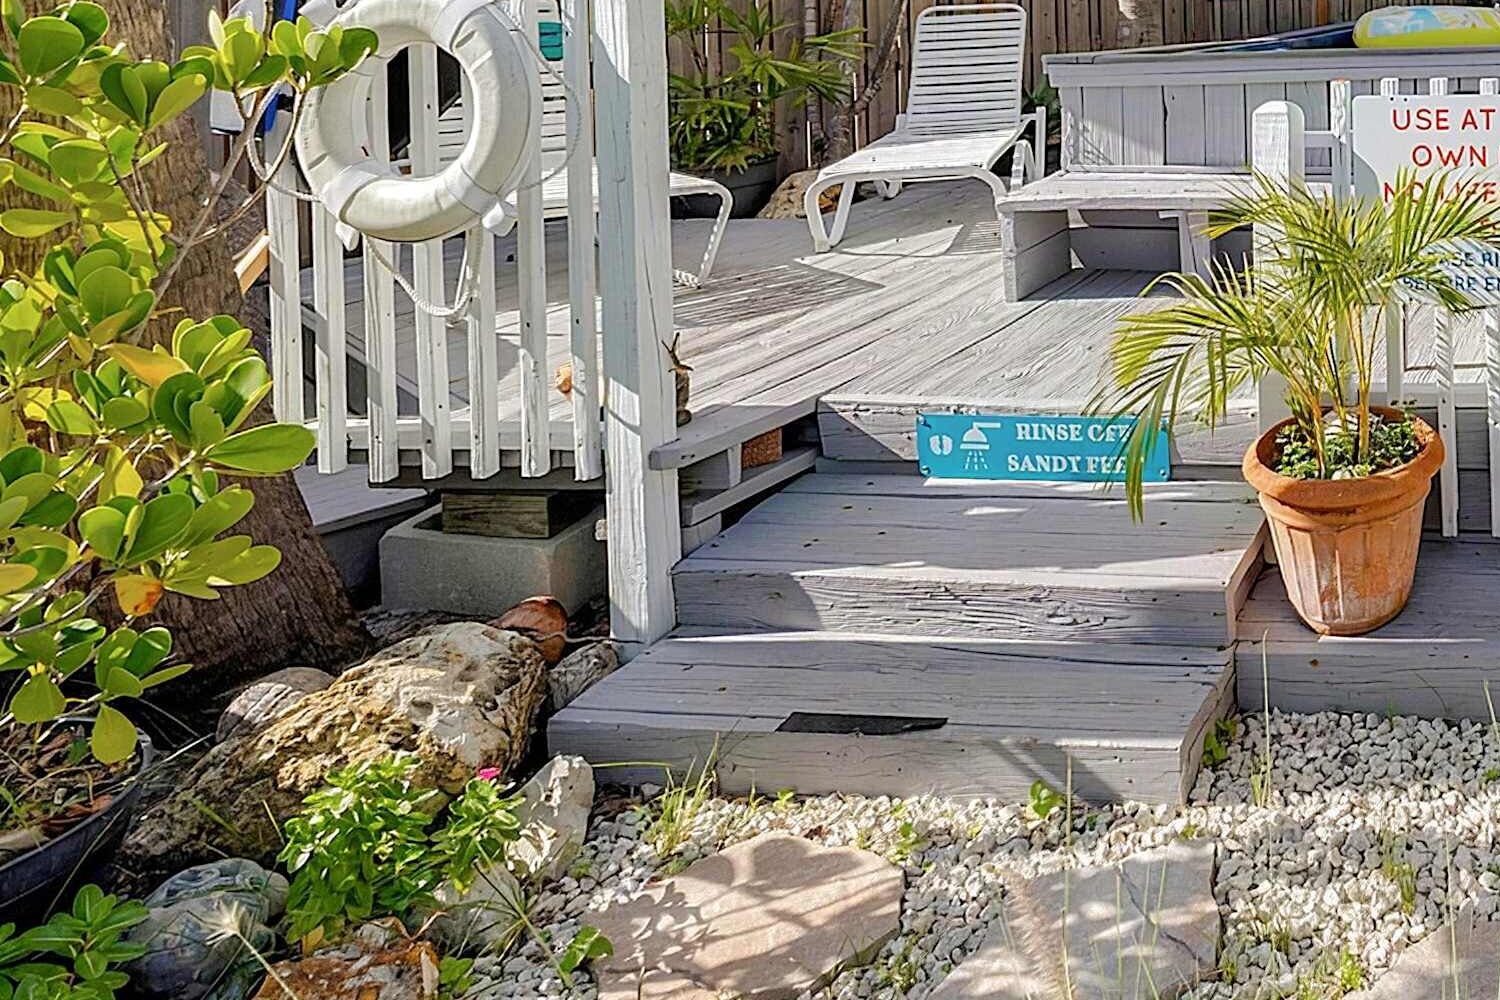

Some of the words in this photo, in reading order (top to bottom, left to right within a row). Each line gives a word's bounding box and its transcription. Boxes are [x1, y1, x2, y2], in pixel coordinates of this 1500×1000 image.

[1392, 108, 1450, 131] USE
[1460, 108, 1496, 131] AT
[1411, 144, 1487, 168] OWN
[1015, 423, 1084, 441] RINSE
[1007, 454, 1082, 473] SANDY
[1086, 456, 1144, 474] FEE
